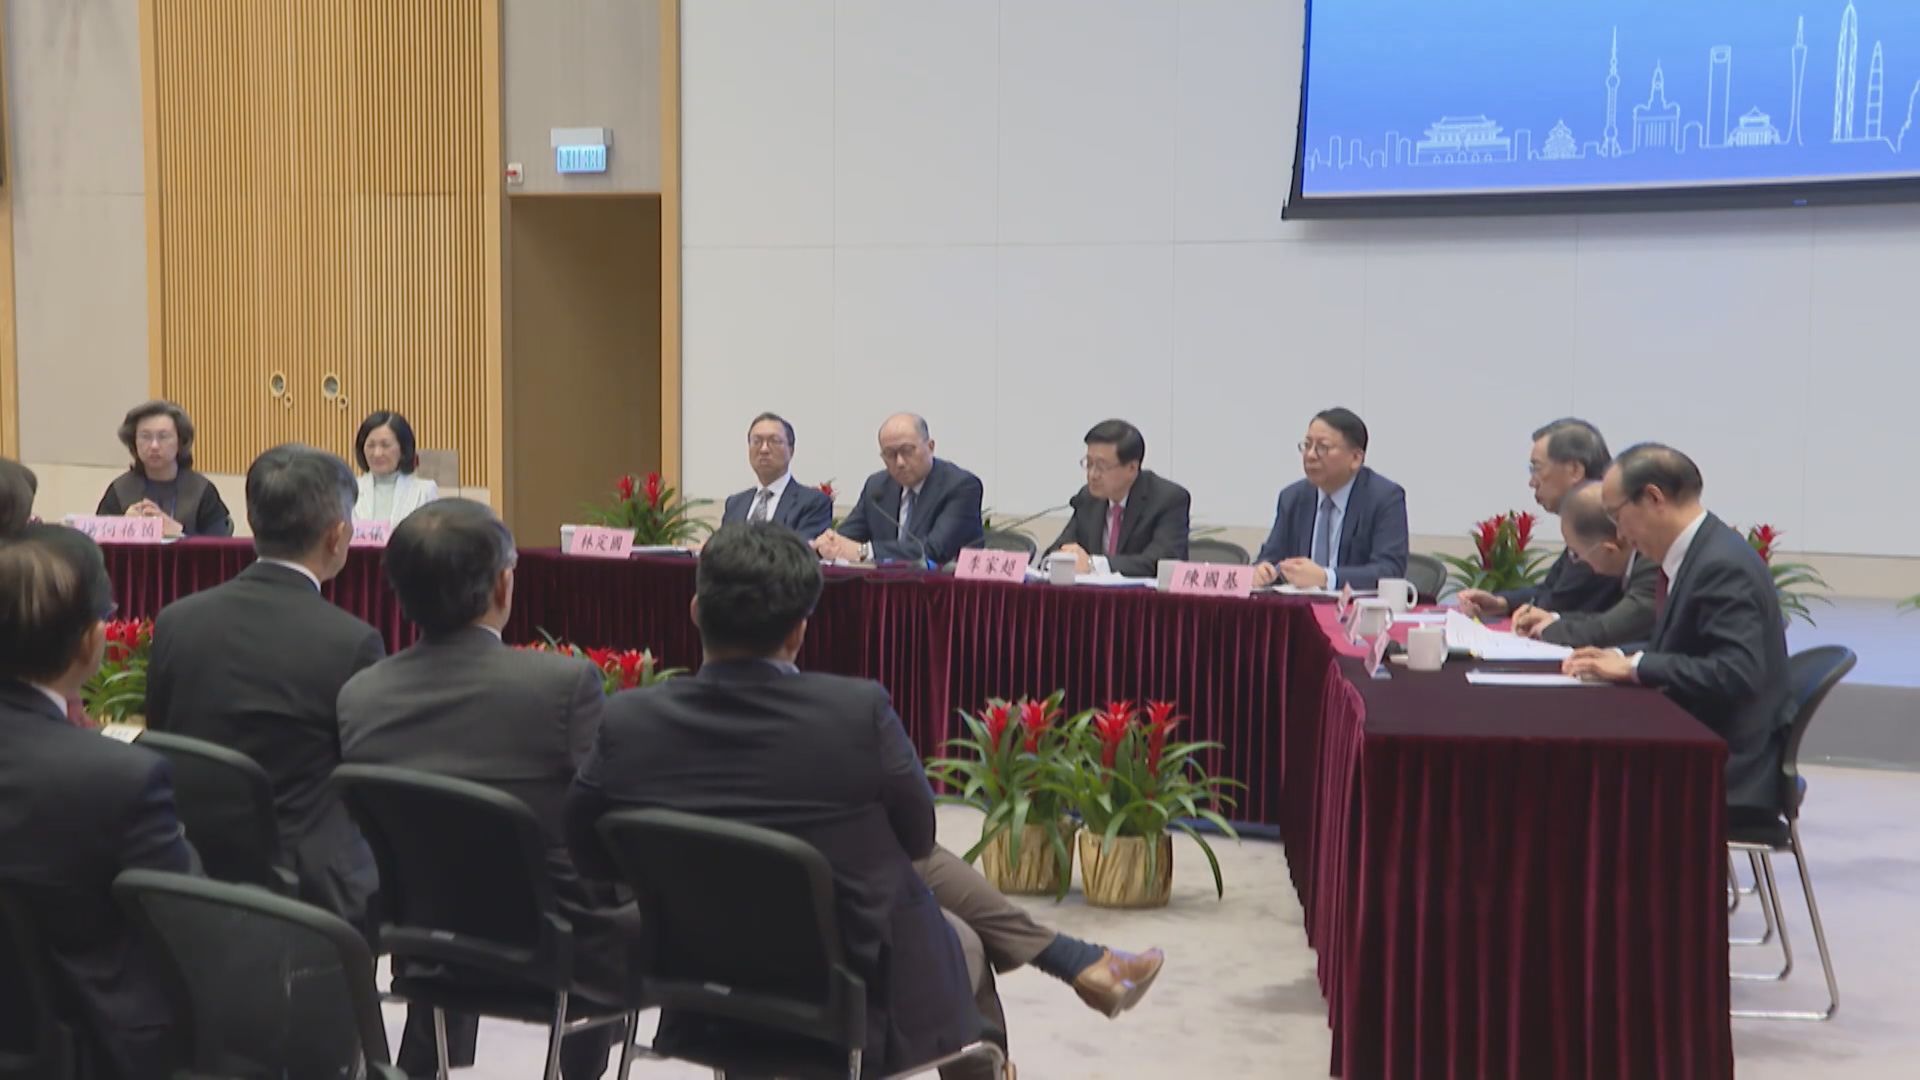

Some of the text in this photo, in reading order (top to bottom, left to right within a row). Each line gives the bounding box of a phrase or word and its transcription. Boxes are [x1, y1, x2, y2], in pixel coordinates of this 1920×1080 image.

[581, 533, 624, 552] 林定國
[967, 554, 1017, 577] 李家超
[1182, 568, 1239, 592] 陳國基
